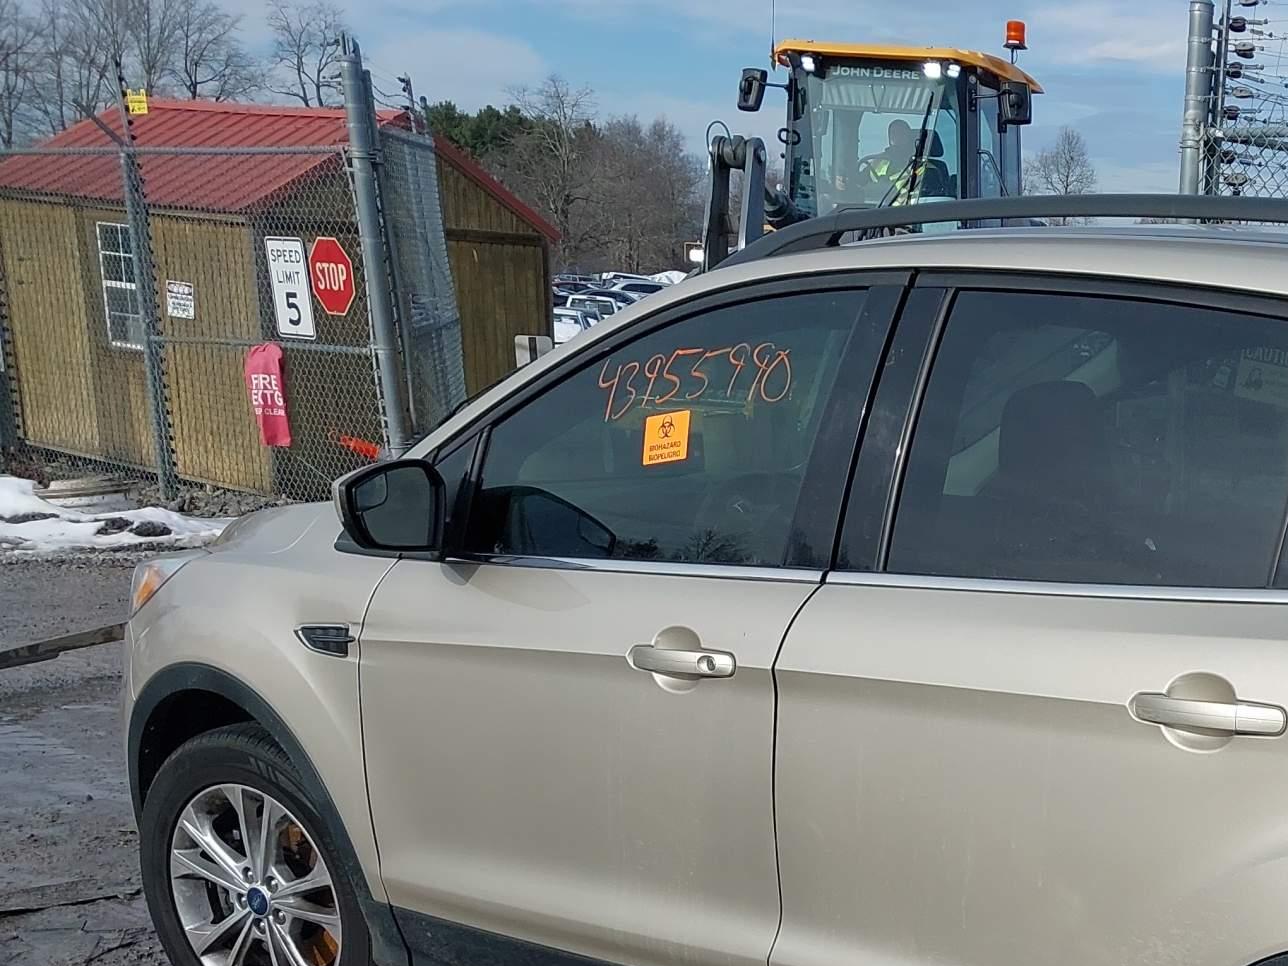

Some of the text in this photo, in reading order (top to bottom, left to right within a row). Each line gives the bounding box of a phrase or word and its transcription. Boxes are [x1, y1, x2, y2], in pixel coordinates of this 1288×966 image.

[831, 64, 920, 80] JOHN DEERE
[270, 248, 301, 264] SPEED
[276, 270, 300, 285] LIMIT
[315, 262, 347, 291] STOP
[285, 292, 302, 326] 5
[251, 374, 279, 390] FIRE
[597, 342, 793, 423] 43955990
[649, 440, 682, 452] BIOHAZARD
[648, 450, 681, 462] BIOPELIGRO
